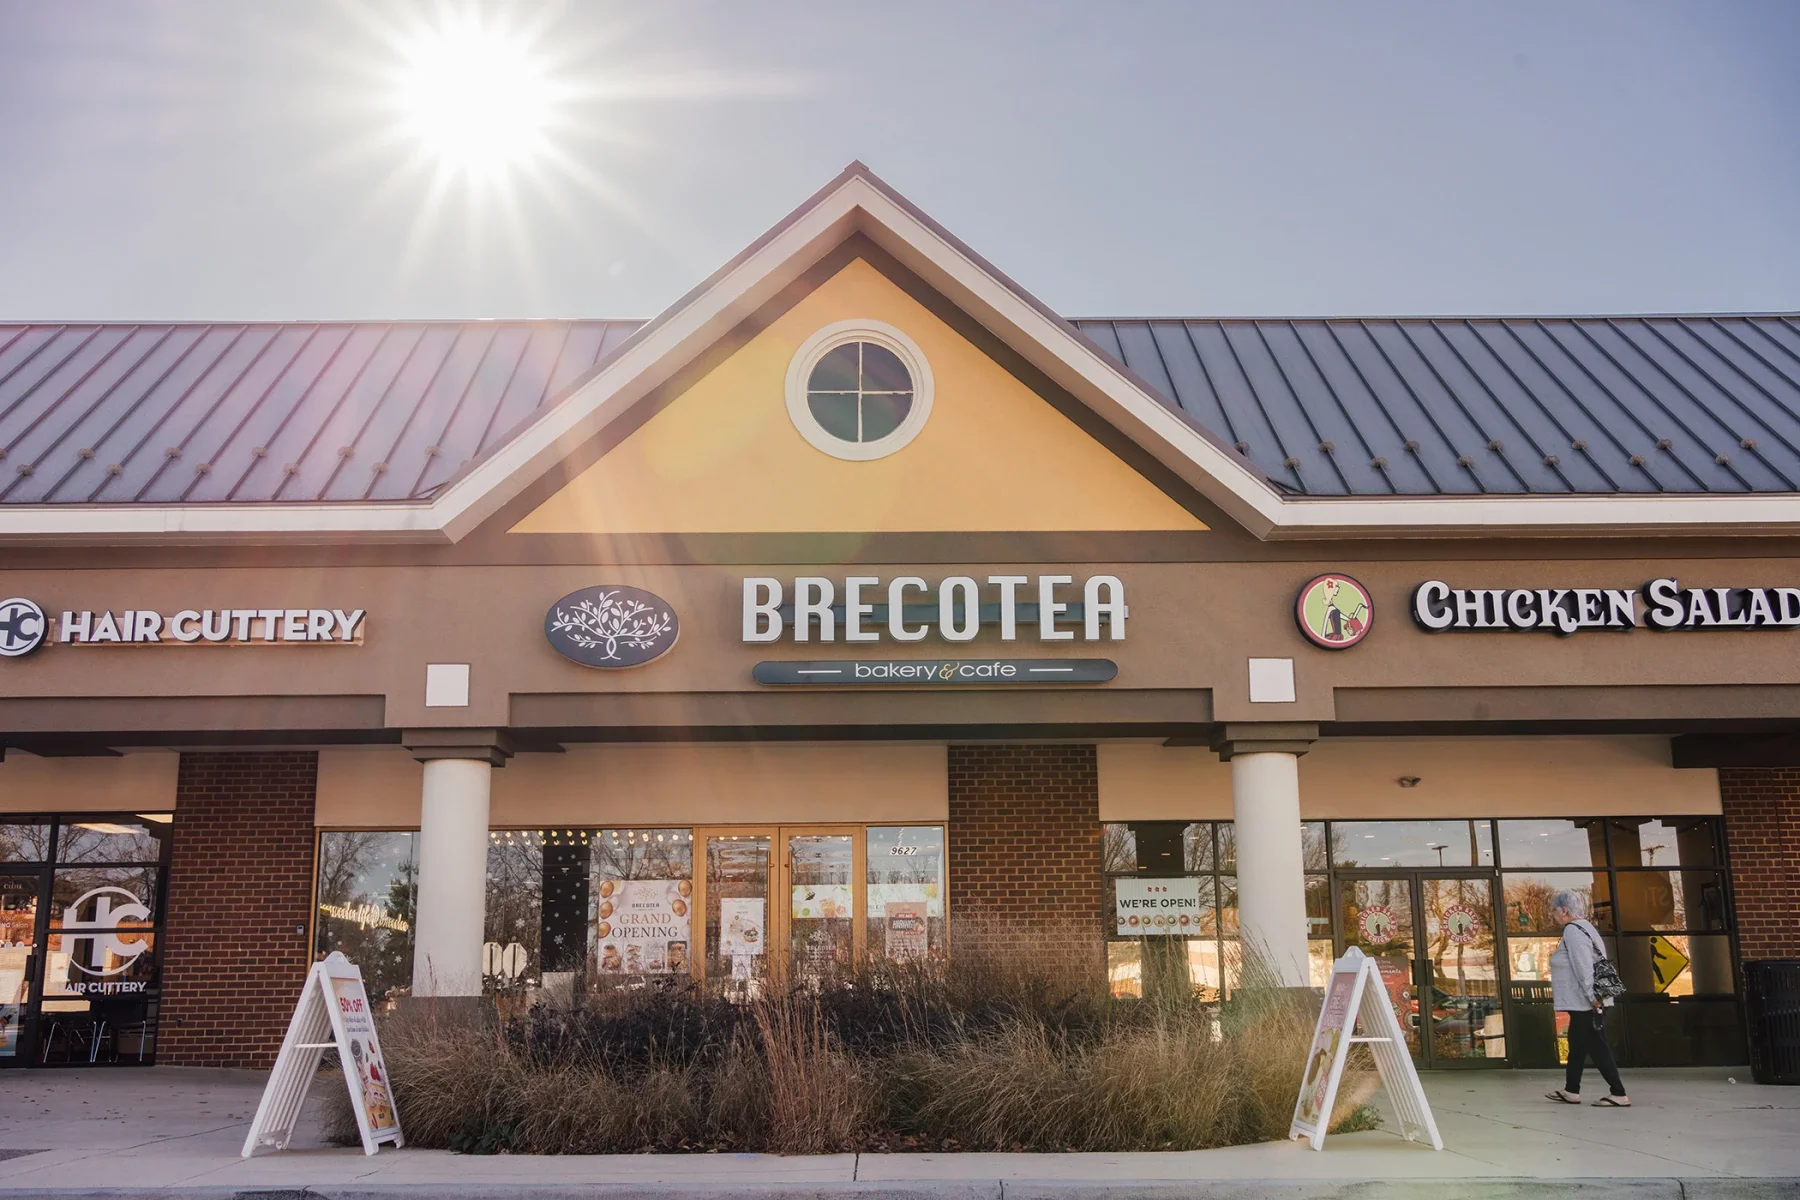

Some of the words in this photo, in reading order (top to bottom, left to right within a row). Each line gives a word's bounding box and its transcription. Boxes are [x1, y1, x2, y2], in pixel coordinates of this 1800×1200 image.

[742, 575, 1126, 643] BRECOTEA
[1416, 580, 1637, 633] CHICKEN
[1649, 578, 1800, 627] SALAD
[60, 610, 161, 643] HAIR
[170, 609, 366, 642] CUTTERY
[854, 662, 938, 680] bakery
[938, 661, 960, 681] &
[959, 661, 1017, 678] cafe
[891, 846, 917, 855] 9627
[1119, 899, 1157, 909] WE'RE
[1160, 898, 1196, 909] OPEN!
[619, 913, 672, 925] GRAND
[611, 926, 679, 939] OPENING
[352, 998, 363, 1013] OFF
